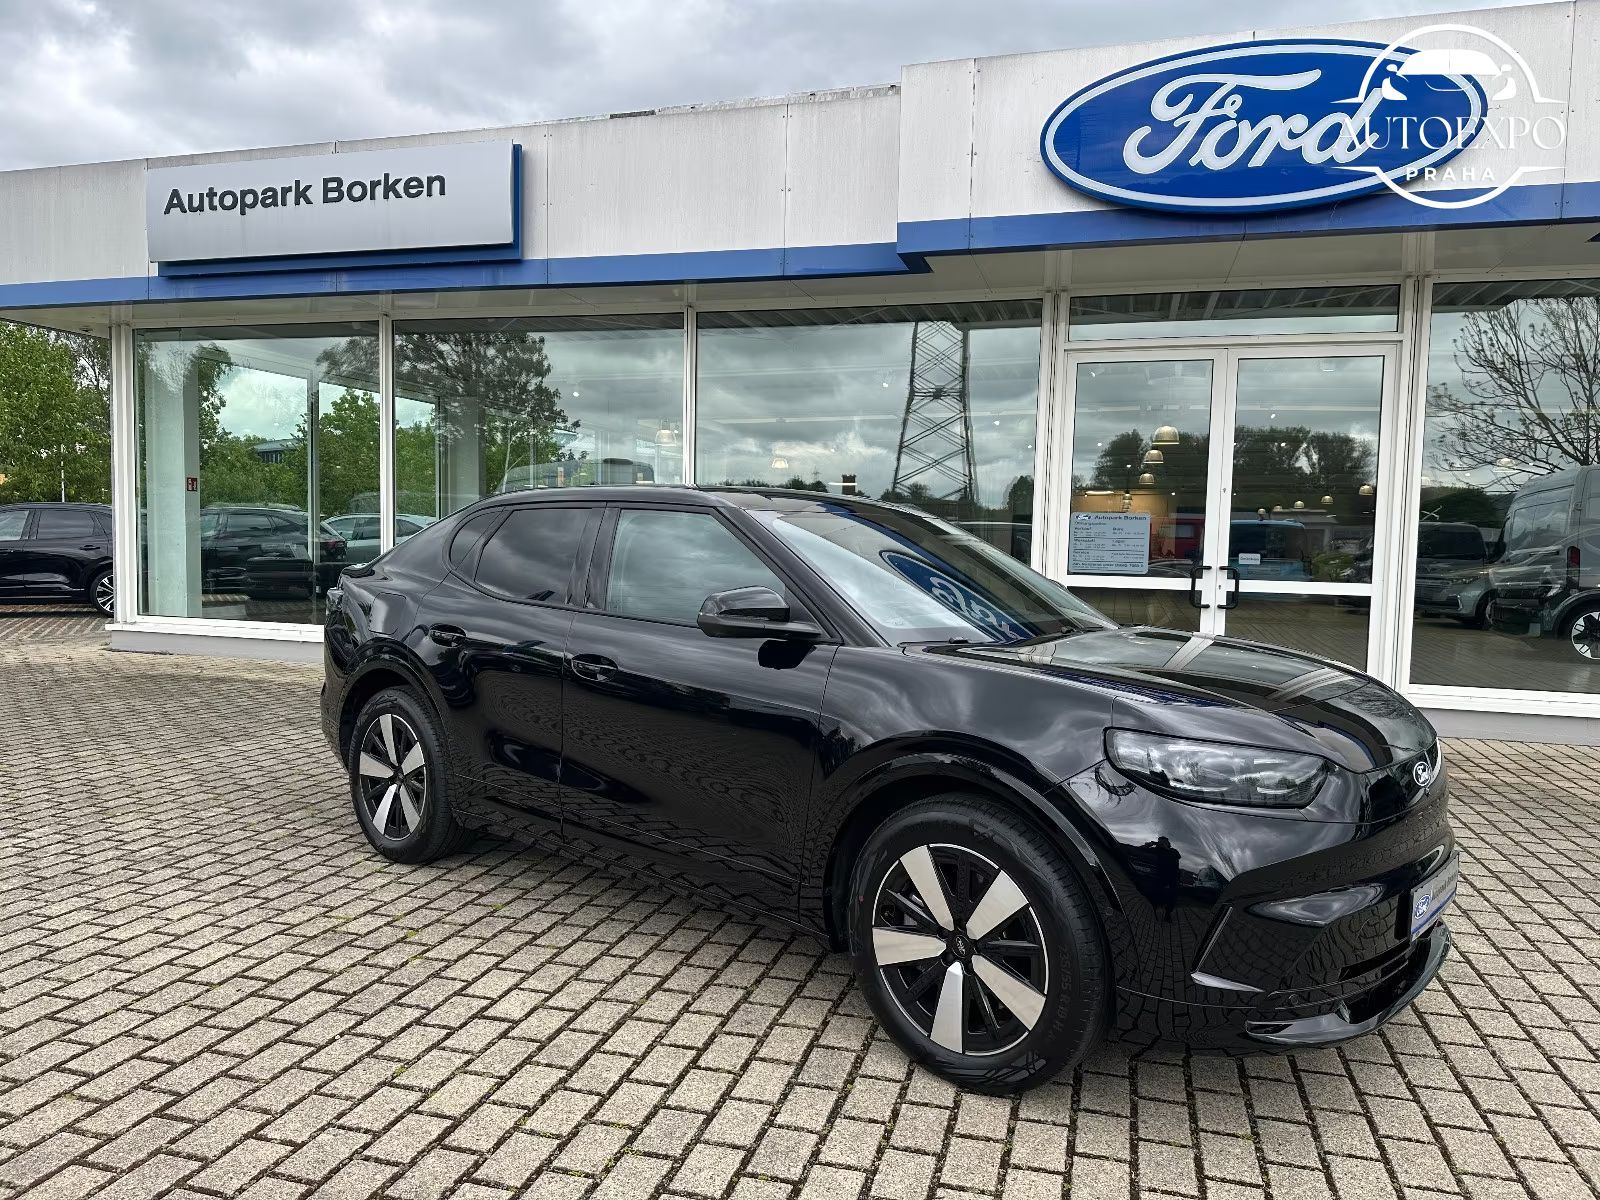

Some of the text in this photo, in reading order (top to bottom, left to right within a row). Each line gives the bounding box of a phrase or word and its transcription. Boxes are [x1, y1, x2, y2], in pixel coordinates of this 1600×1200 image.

[1123, 69, 1383, 174] Ford
[163, 172, 446, 216] Autopark Borken
